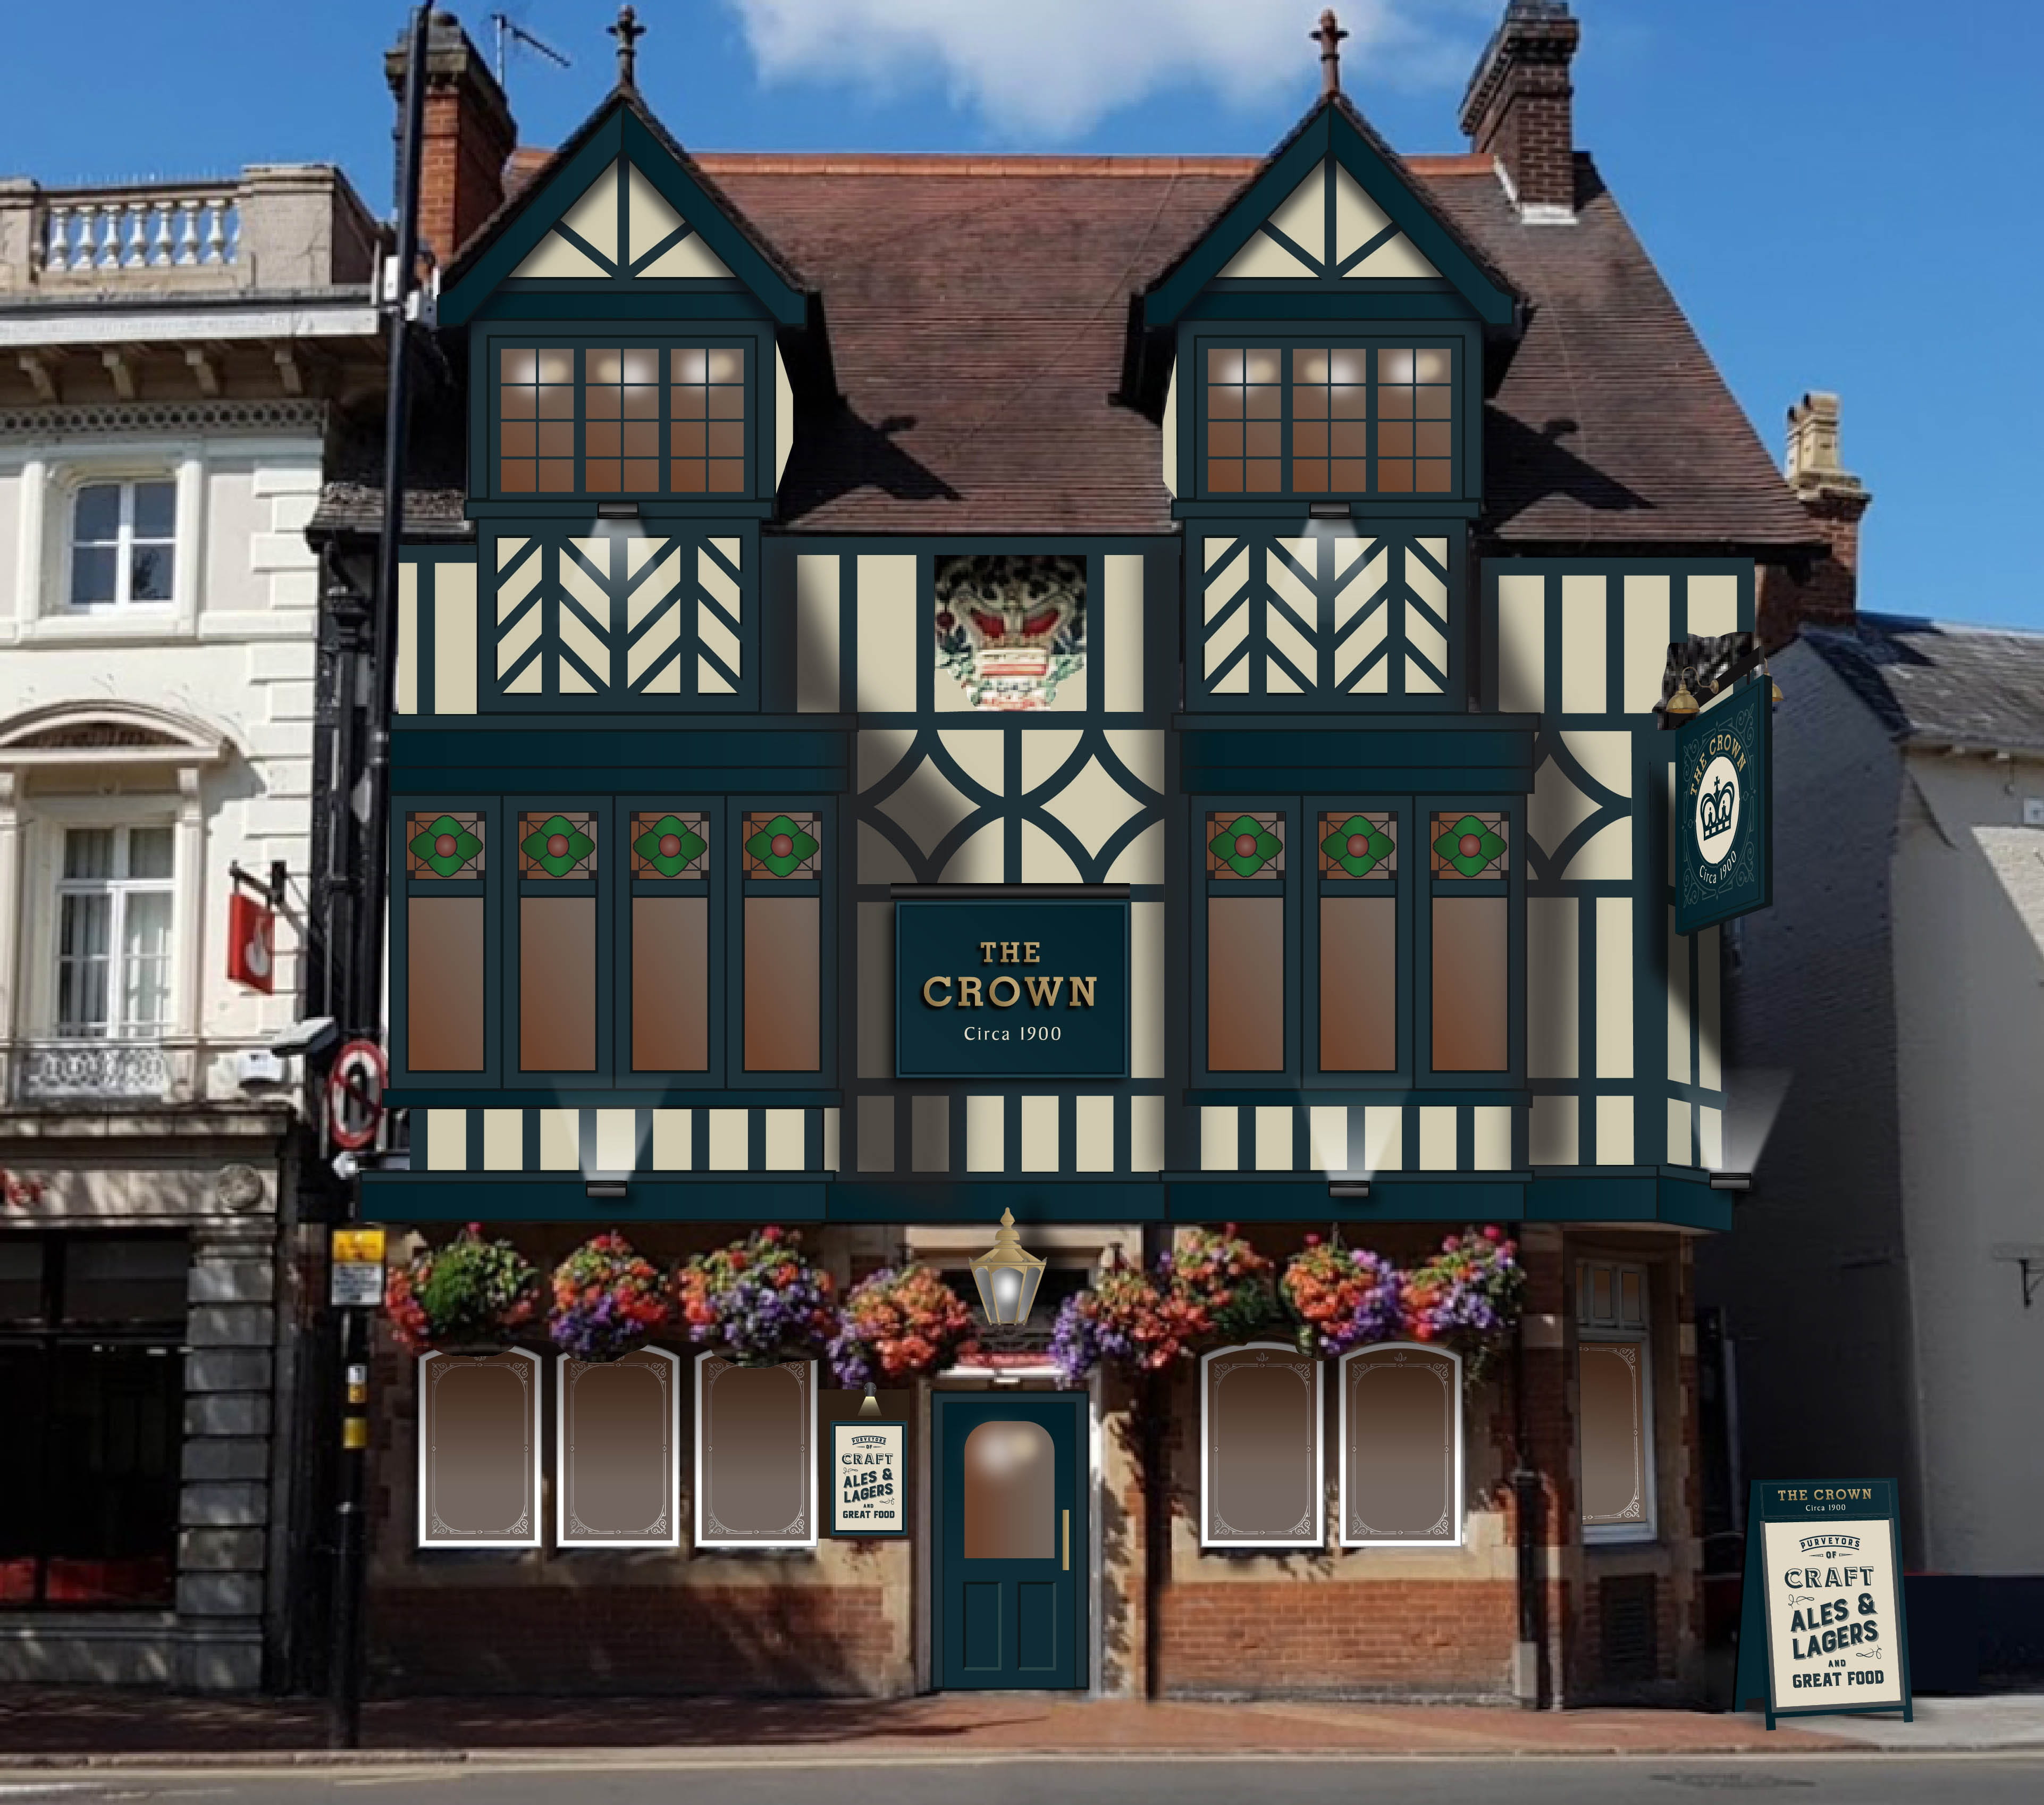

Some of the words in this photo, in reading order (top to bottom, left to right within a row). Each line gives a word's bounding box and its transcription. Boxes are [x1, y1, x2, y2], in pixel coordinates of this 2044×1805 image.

[1690, 752, 1707, 796] THE
[1709, 734, 1746, 773] CROWN
[1700, 865, 1717, 884] Circa
[1720, 851, 1737, 879] 1900
[980, 942, 1040, 963] THE
[923, 976, 1097, 1007] CROWN
[964, 1026, 1010, 1040] Circa
[1020, 1026, 1062, 1040] 1900
[842, 1453, 894, 1465] CRAFT
[843, 1471, 877, 1488] ALES
[882, 1468, 894, 1480] &
[844, 1483, 894, 1504] LAGERS
[1778, 1489, 1808, 1501] THE
[1813, 1488, 1872, 1501] CROWN
[1800, 1537, 1860, 1549] PURVEYORS
[1784, 1566, 1874, 1589] CRAFT
[1790, 1598, 1849, 1634] ALES
[1857, 1592, 1879, 1616] &
[1792, 1619, 1879, 1661] LAGERS
[1828, 1659, 1846, 1668] AND
[1792, 1672, 1843, 1689] GREAT
[1847, 1670, 1885, 1686] FOOD
